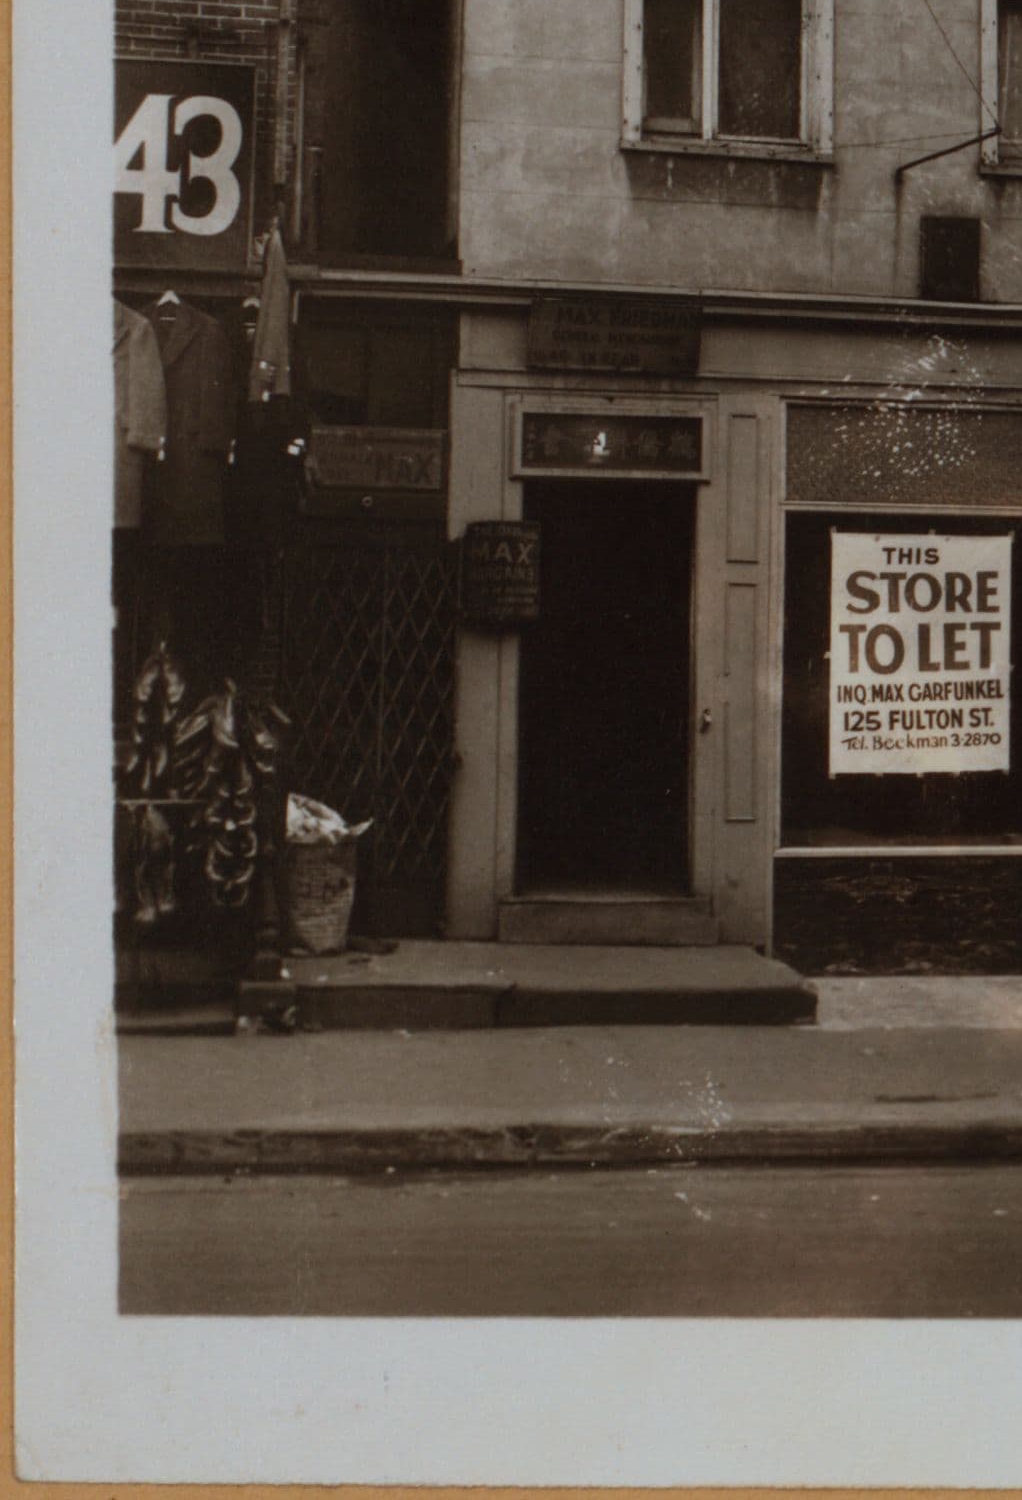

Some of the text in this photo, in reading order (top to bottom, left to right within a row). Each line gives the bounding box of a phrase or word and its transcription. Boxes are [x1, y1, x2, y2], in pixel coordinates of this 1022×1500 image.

[113, 92, 244, 237] 43
[375, 451, 435, 484] MAX
[470, 541, 535, 564] MAX
[882, 547, 940, 565] THIS
[845, 570, 1000, 615] STORE
[839, 621, 1002, 675] TO LET
[871, 682, 905, 703] MAX
[908, 678, 1004, 702] GARFUNKEL
[844, 706, 995, 732] 125 FULTON ST.
